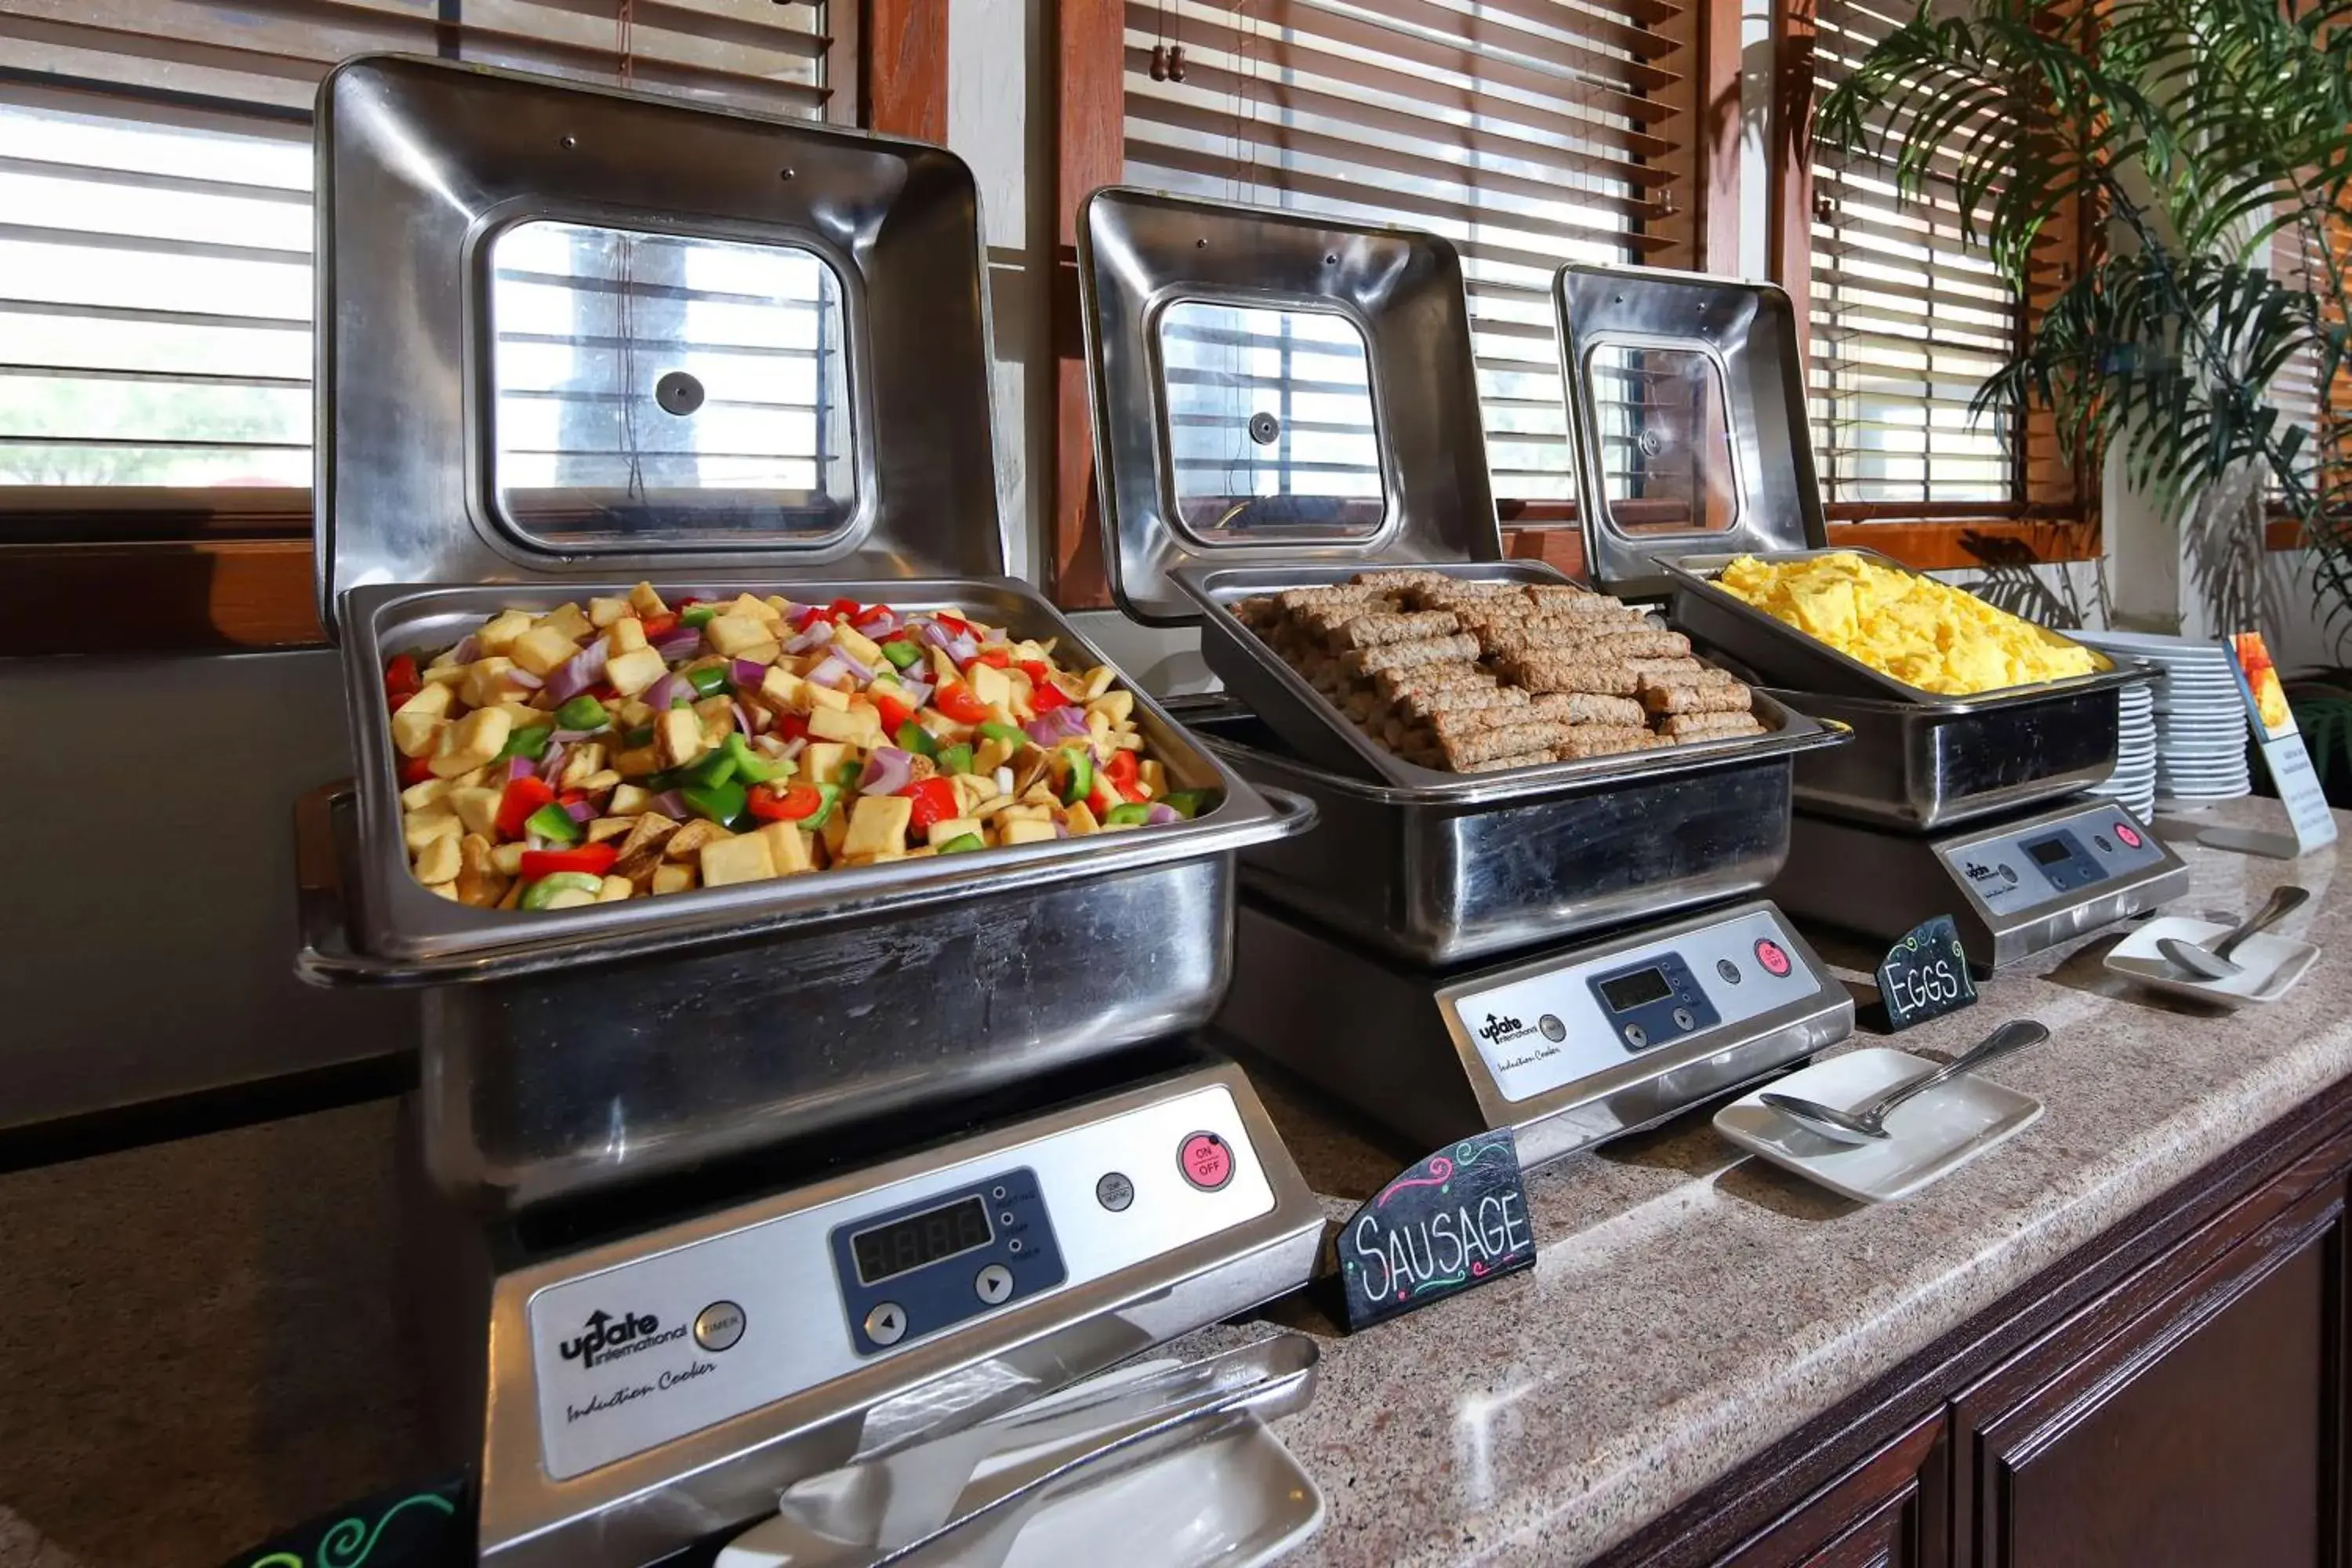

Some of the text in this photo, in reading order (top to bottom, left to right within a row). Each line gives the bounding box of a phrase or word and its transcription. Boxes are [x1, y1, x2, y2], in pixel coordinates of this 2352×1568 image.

[1884, 960, 1958, 1014] EGGS
[1196, 1146, 1212, 1159] ON
[1199, 1161, 1220, 1176] OFF
[1356, 1192, 1530, 1301] SAUSAGE
[560, 1310, 659, 1369] update
[594, 1325, 688, 1367] international
[702, 1316, 740, 1336] TIMER
[567, 1362, 717, 1423] Induction Cooker
